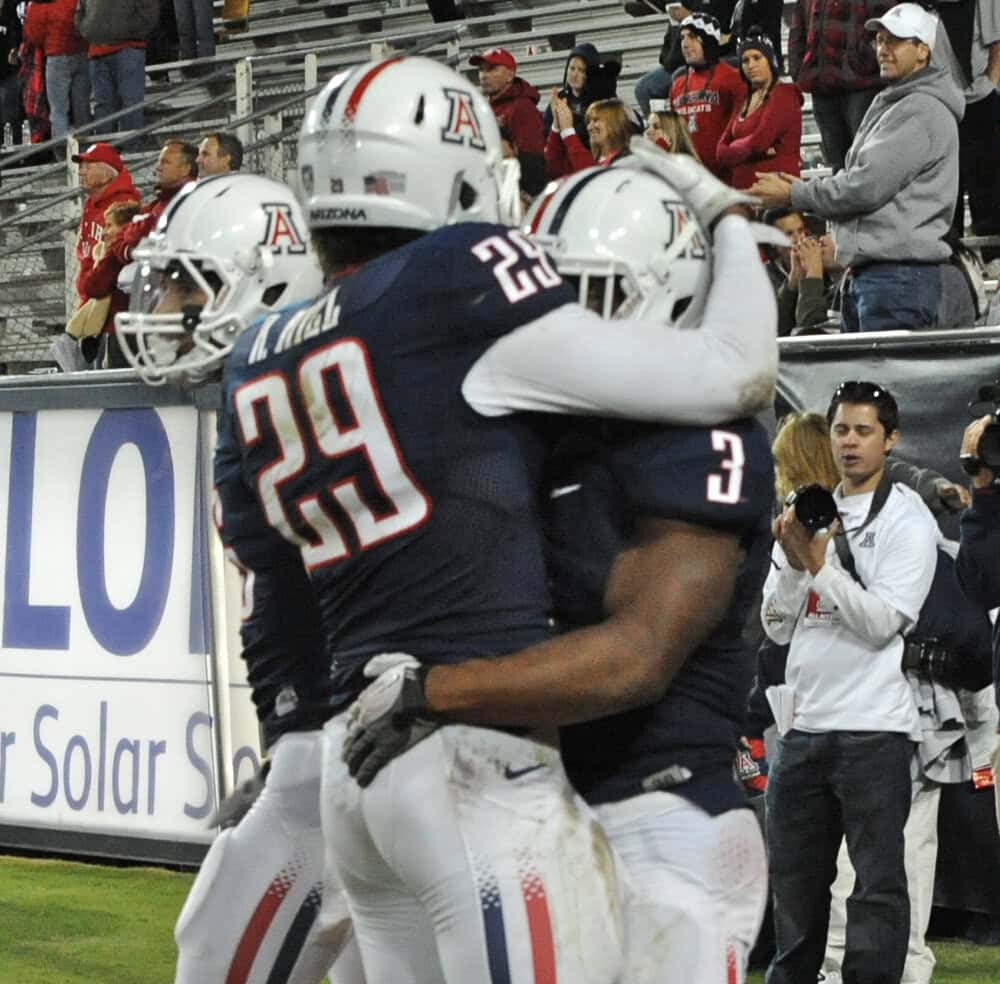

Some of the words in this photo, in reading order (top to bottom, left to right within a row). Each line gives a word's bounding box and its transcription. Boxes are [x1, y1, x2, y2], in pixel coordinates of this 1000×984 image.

[441, 87, 487, 152] A
[258, 202, 306, 255] A
[471, 228, 563, 304] 29
[233, 335, 433, 572] 29
[706, 429, 745, 504] 3
[3, 407, 210, 657] LO
[30, 700, 167, 816] Solar
